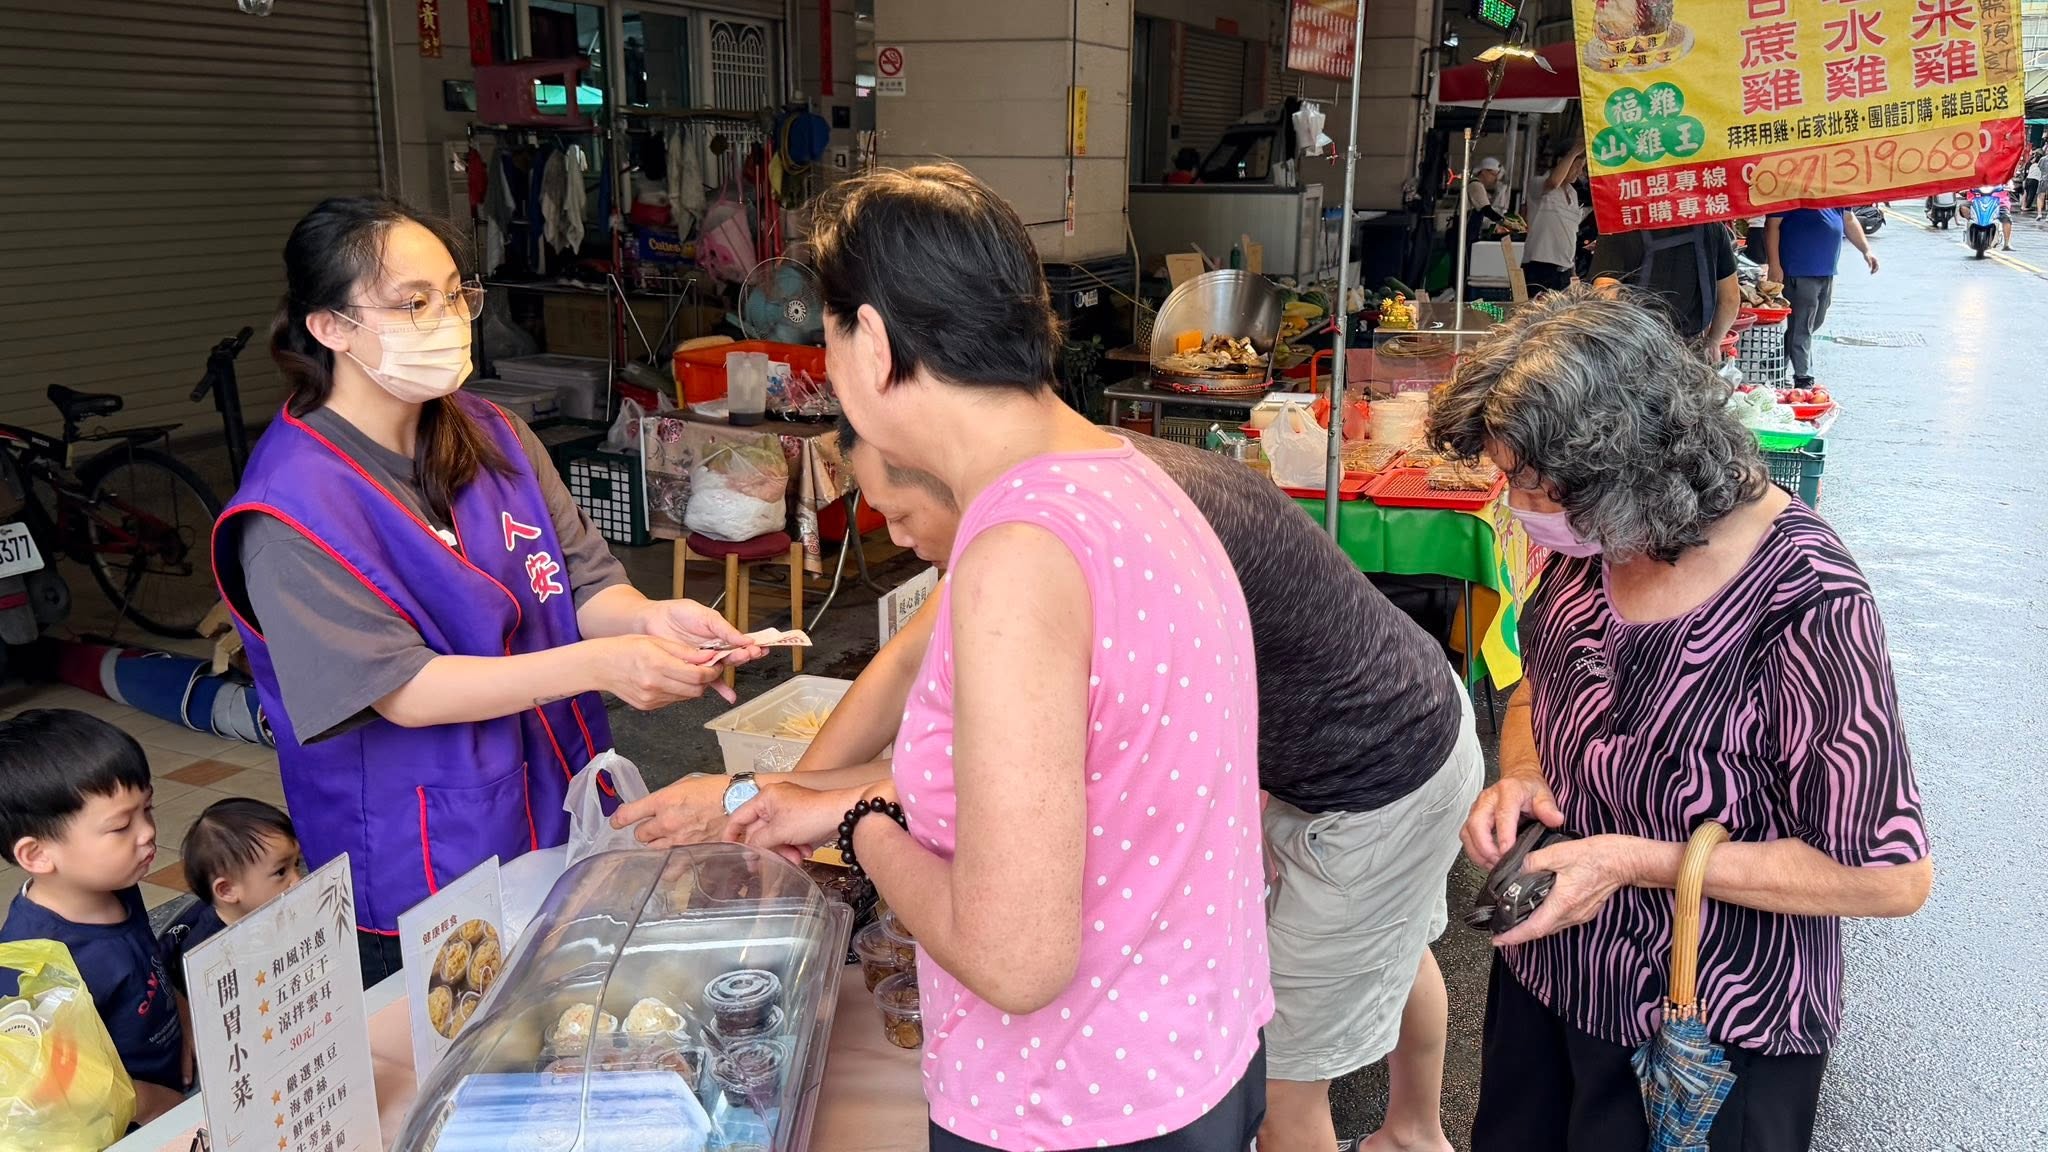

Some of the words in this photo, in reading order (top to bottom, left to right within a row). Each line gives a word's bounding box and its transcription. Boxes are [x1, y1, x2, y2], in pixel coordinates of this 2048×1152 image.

[1822, 0, 1887, 102] 水雞
[1618, 166, 1727, 200] 加盟專線
[1755, 131, 1975, 196] 0971319068
[1621, 193, 1730, 225] 訂購專線
[0, 535, 31, 565] 377
[502, 511, 563, 603] 人安
[276, 954, 329, 1006] 五香豆干
[279, 980, 332, 1034] 涼拌雲耳
[217, 968, 254, 1113] 開胃小菜
[286, 1042, 338, 1094] 嚴選黑豆
[289, 1076, 328, 1118] 海帶絲
